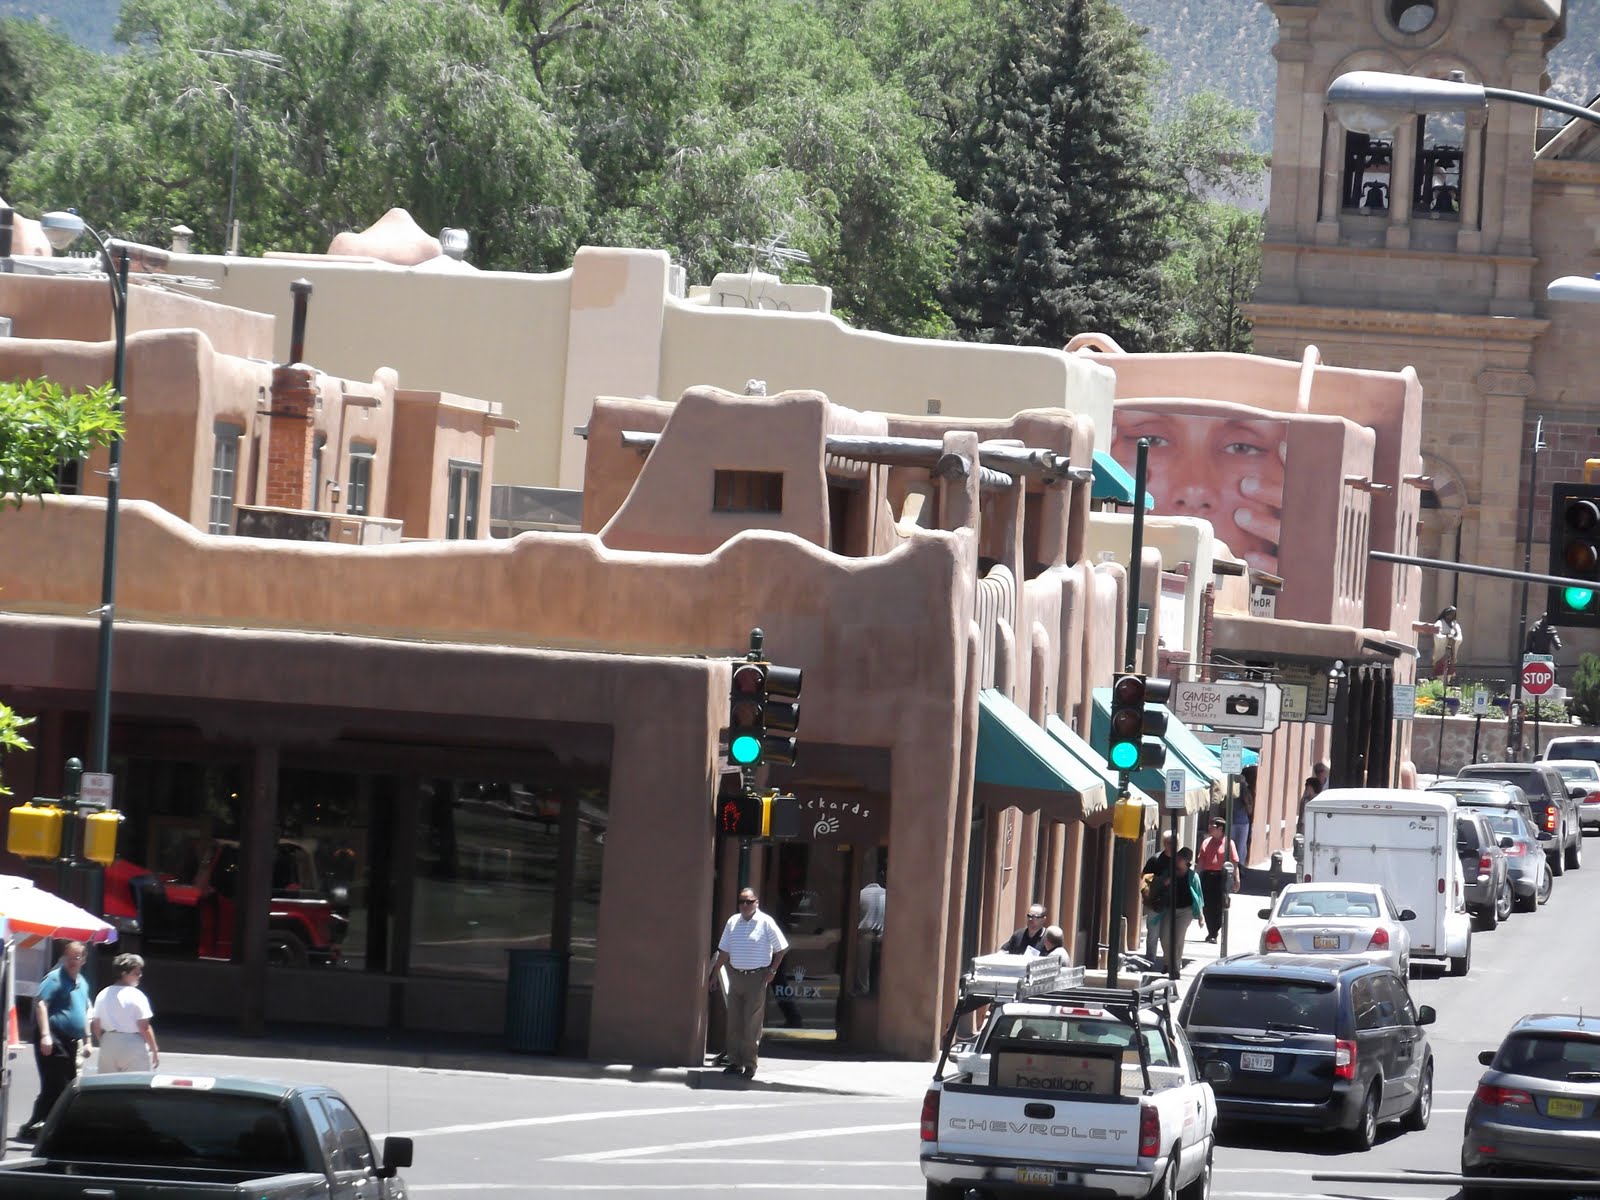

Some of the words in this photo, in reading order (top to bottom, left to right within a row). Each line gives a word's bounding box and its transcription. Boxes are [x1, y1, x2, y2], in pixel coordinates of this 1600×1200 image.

[1523, 672, 1551, 684] STOP
[1182, 691, 1221, 703] CAMERA
[1184, 702, 1214, 712] SHOP
[799, 797, 870, 817] ckards
[775, 985, 822, 998] ROLEX
[1016, 1073, 1095, 1092] heatilator
[949, 1117, 1128, 1141] CHEVROLET
